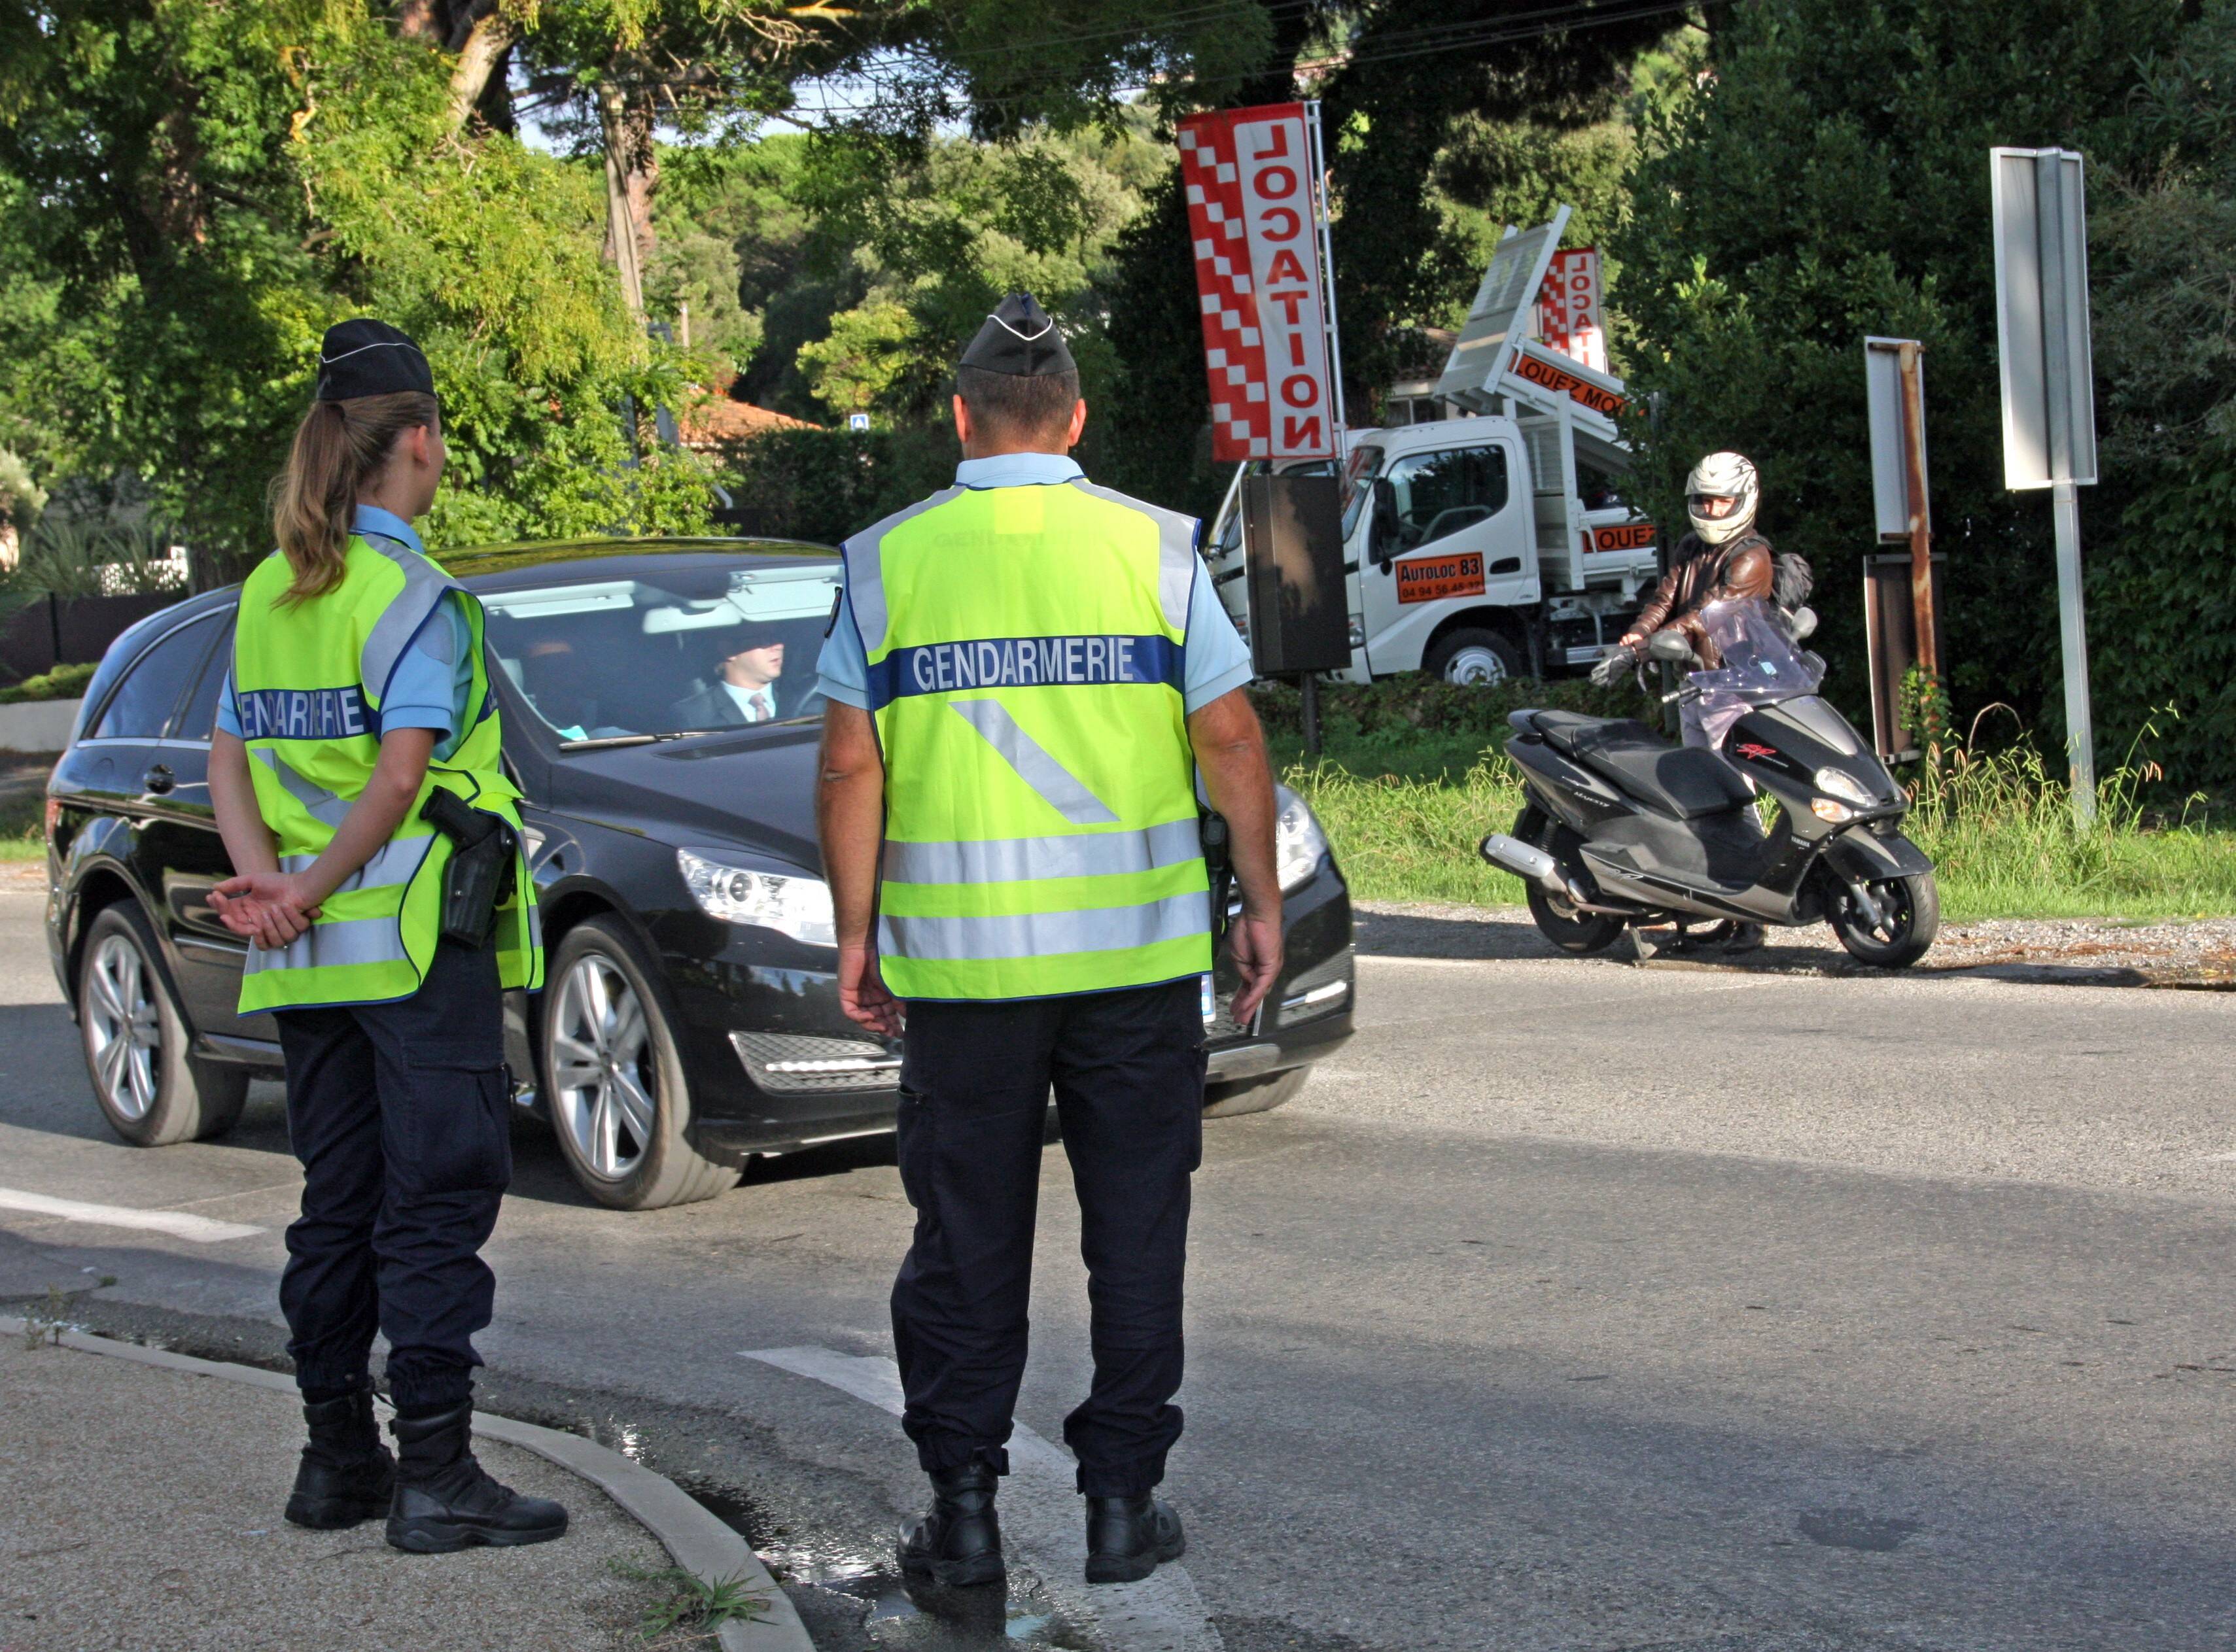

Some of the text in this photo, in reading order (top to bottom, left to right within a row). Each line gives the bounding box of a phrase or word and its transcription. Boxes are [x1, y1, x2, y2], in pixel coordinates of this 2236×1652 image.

[1516, 362, 1581, 400] OUEZ
[1460, 559, 1479, 576] 83
[1403, 587, 1415, 598] 04
[1418, 586, 1432, 596] 94
[913, 638, 1135, 692] GENDARMERIE
